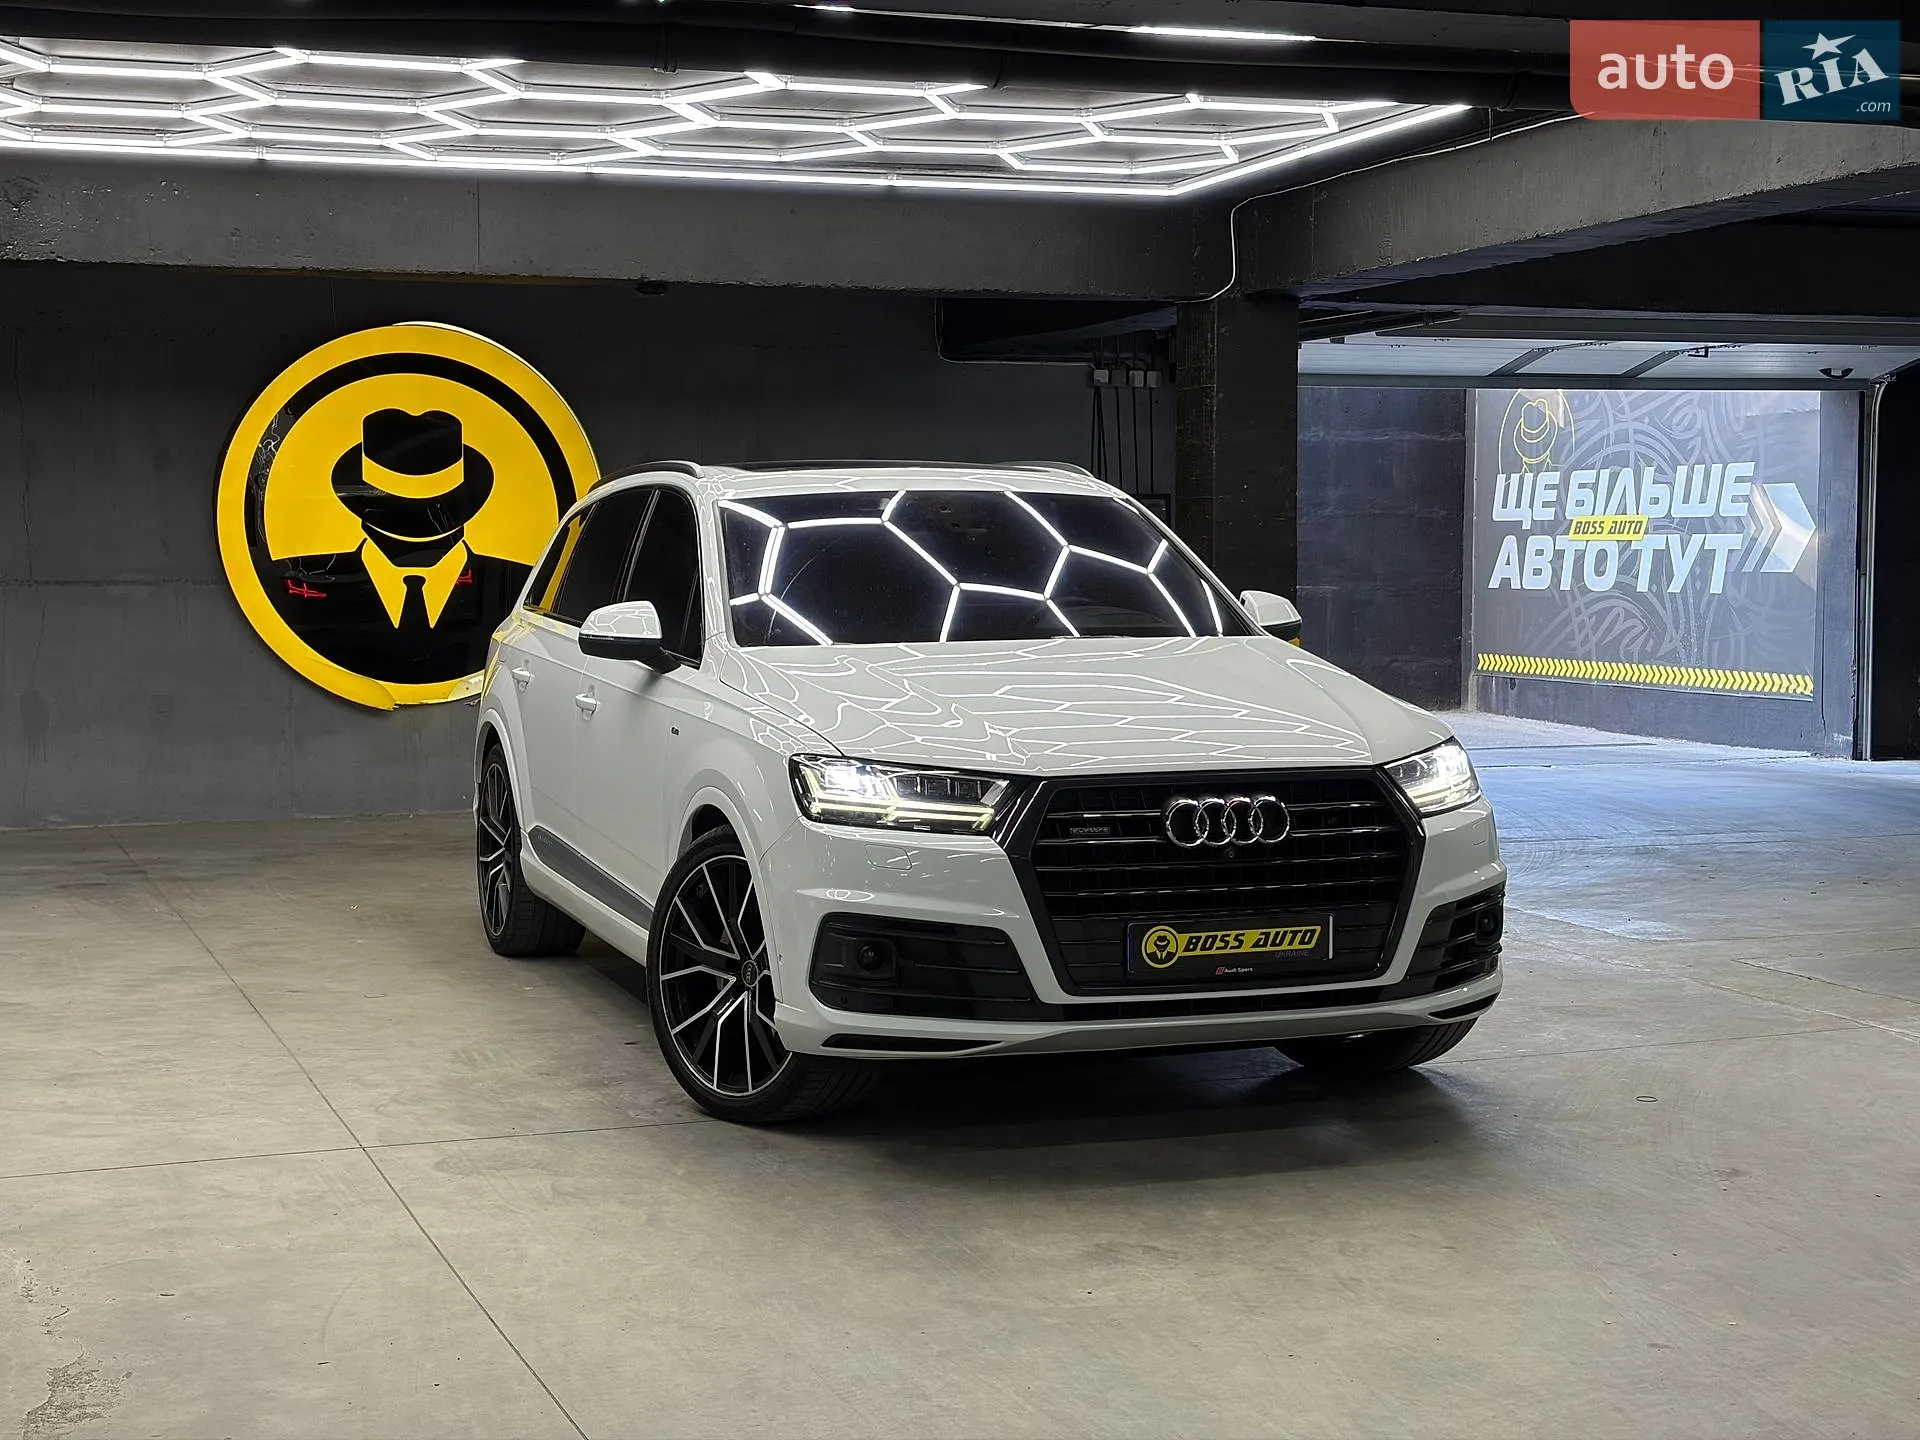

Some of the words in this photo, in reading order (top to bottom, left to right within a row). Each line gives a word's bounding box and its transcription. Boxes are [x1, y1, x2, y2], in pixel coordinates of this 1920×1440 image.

[1492, 471, 1560, 530] ЩЕ
[1565, 462, 1755, 519] БІЛЬШЕ
[1573, 520, 1605, 535] BOSS
[1607, 520, 1643, 535] AUTO
[1488, 534, 1620, 592] АВТО
[1633, 533, 1743, 594] ТУТ
[1182, 932, 1246, 953] BOSS
[1250, 928, 1317, 949] AUTO
